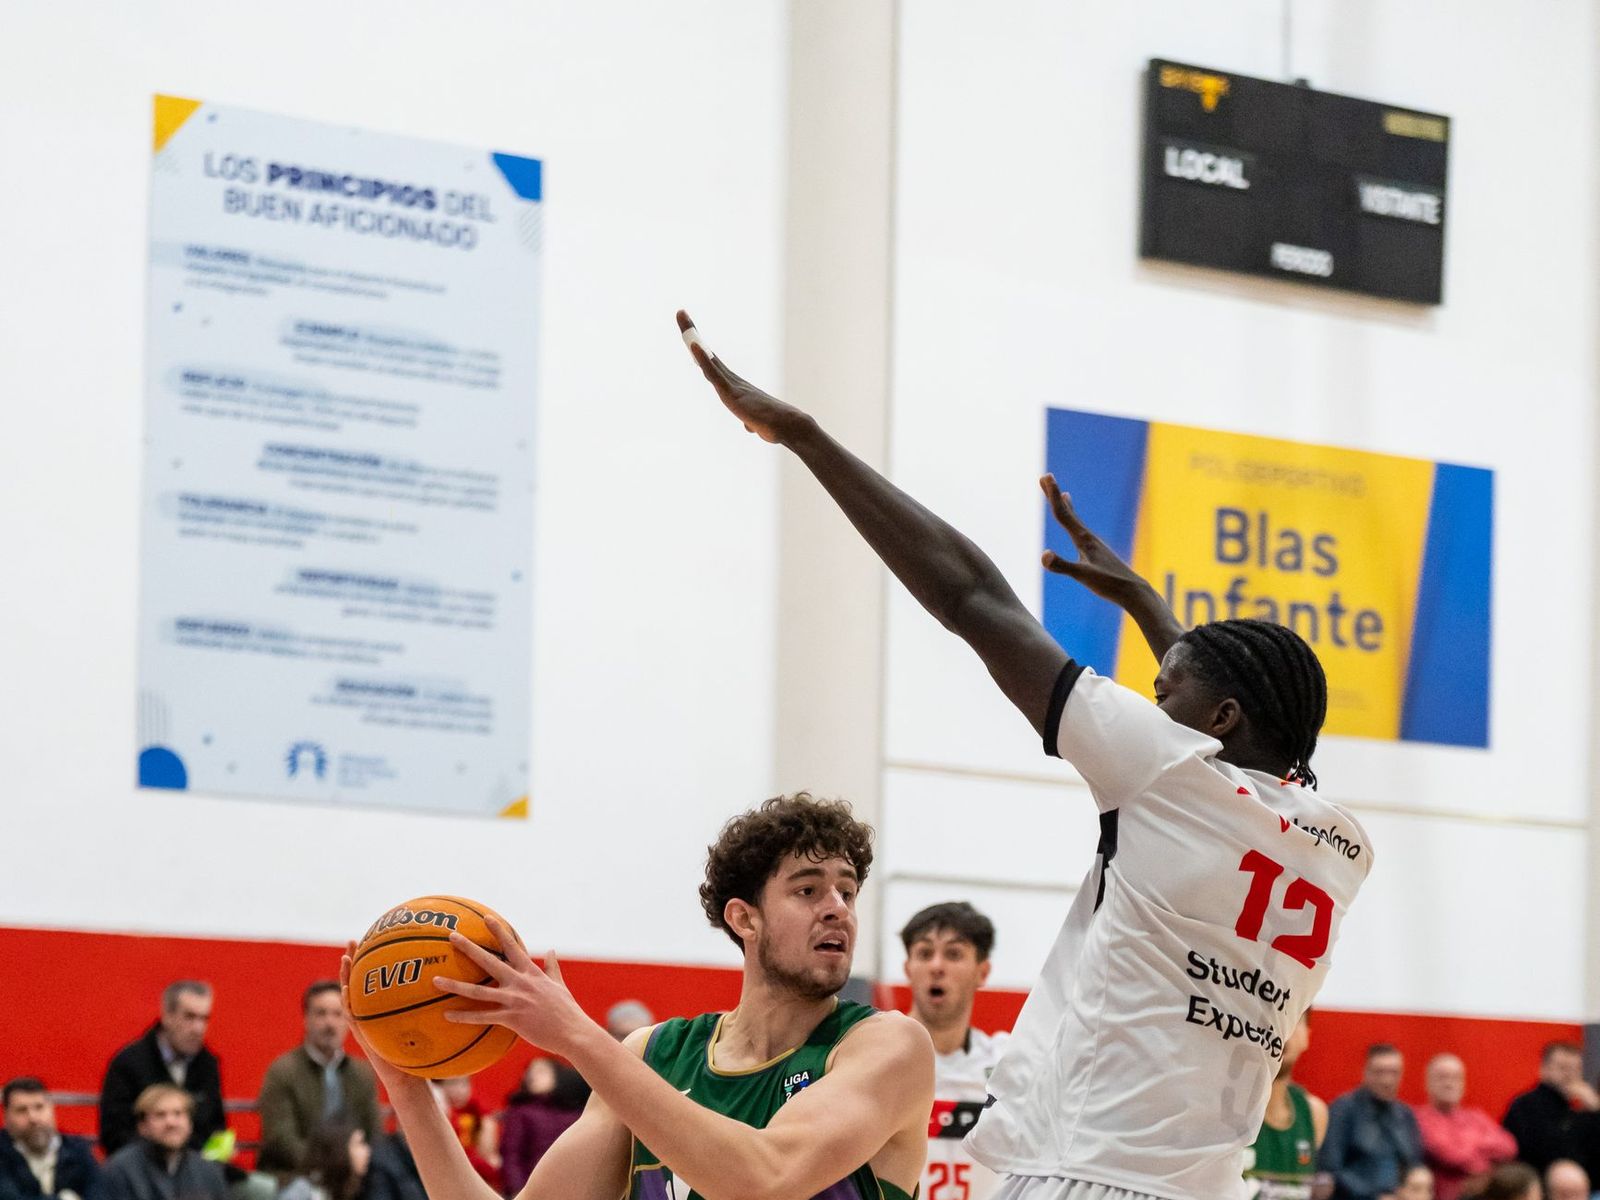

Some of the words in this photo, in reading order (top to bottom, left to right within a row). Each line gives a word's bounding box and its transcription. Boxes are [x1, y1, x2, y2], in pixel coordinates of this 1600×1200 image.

[203, 151, 259, 183] LOS
[267, 162, 438, 211] PRINCIPIOS
[444, 190, 497, 223] DEL
[1164, 145, 1250, 190] LOCAL
[223, 187, 301, 225] BUEN
[307, 204, 479, 251] AFICIONADO
[1214, 506, 1340, 577] Blas
[1164, 572, 1385, 653] Infante
[1235, 849, 1335, 970] 12
[364, 957, 424, 996] EVO
[1185, 995, 1283, 1063] Experie
[784, 1071, 810, 1087] LIGA
